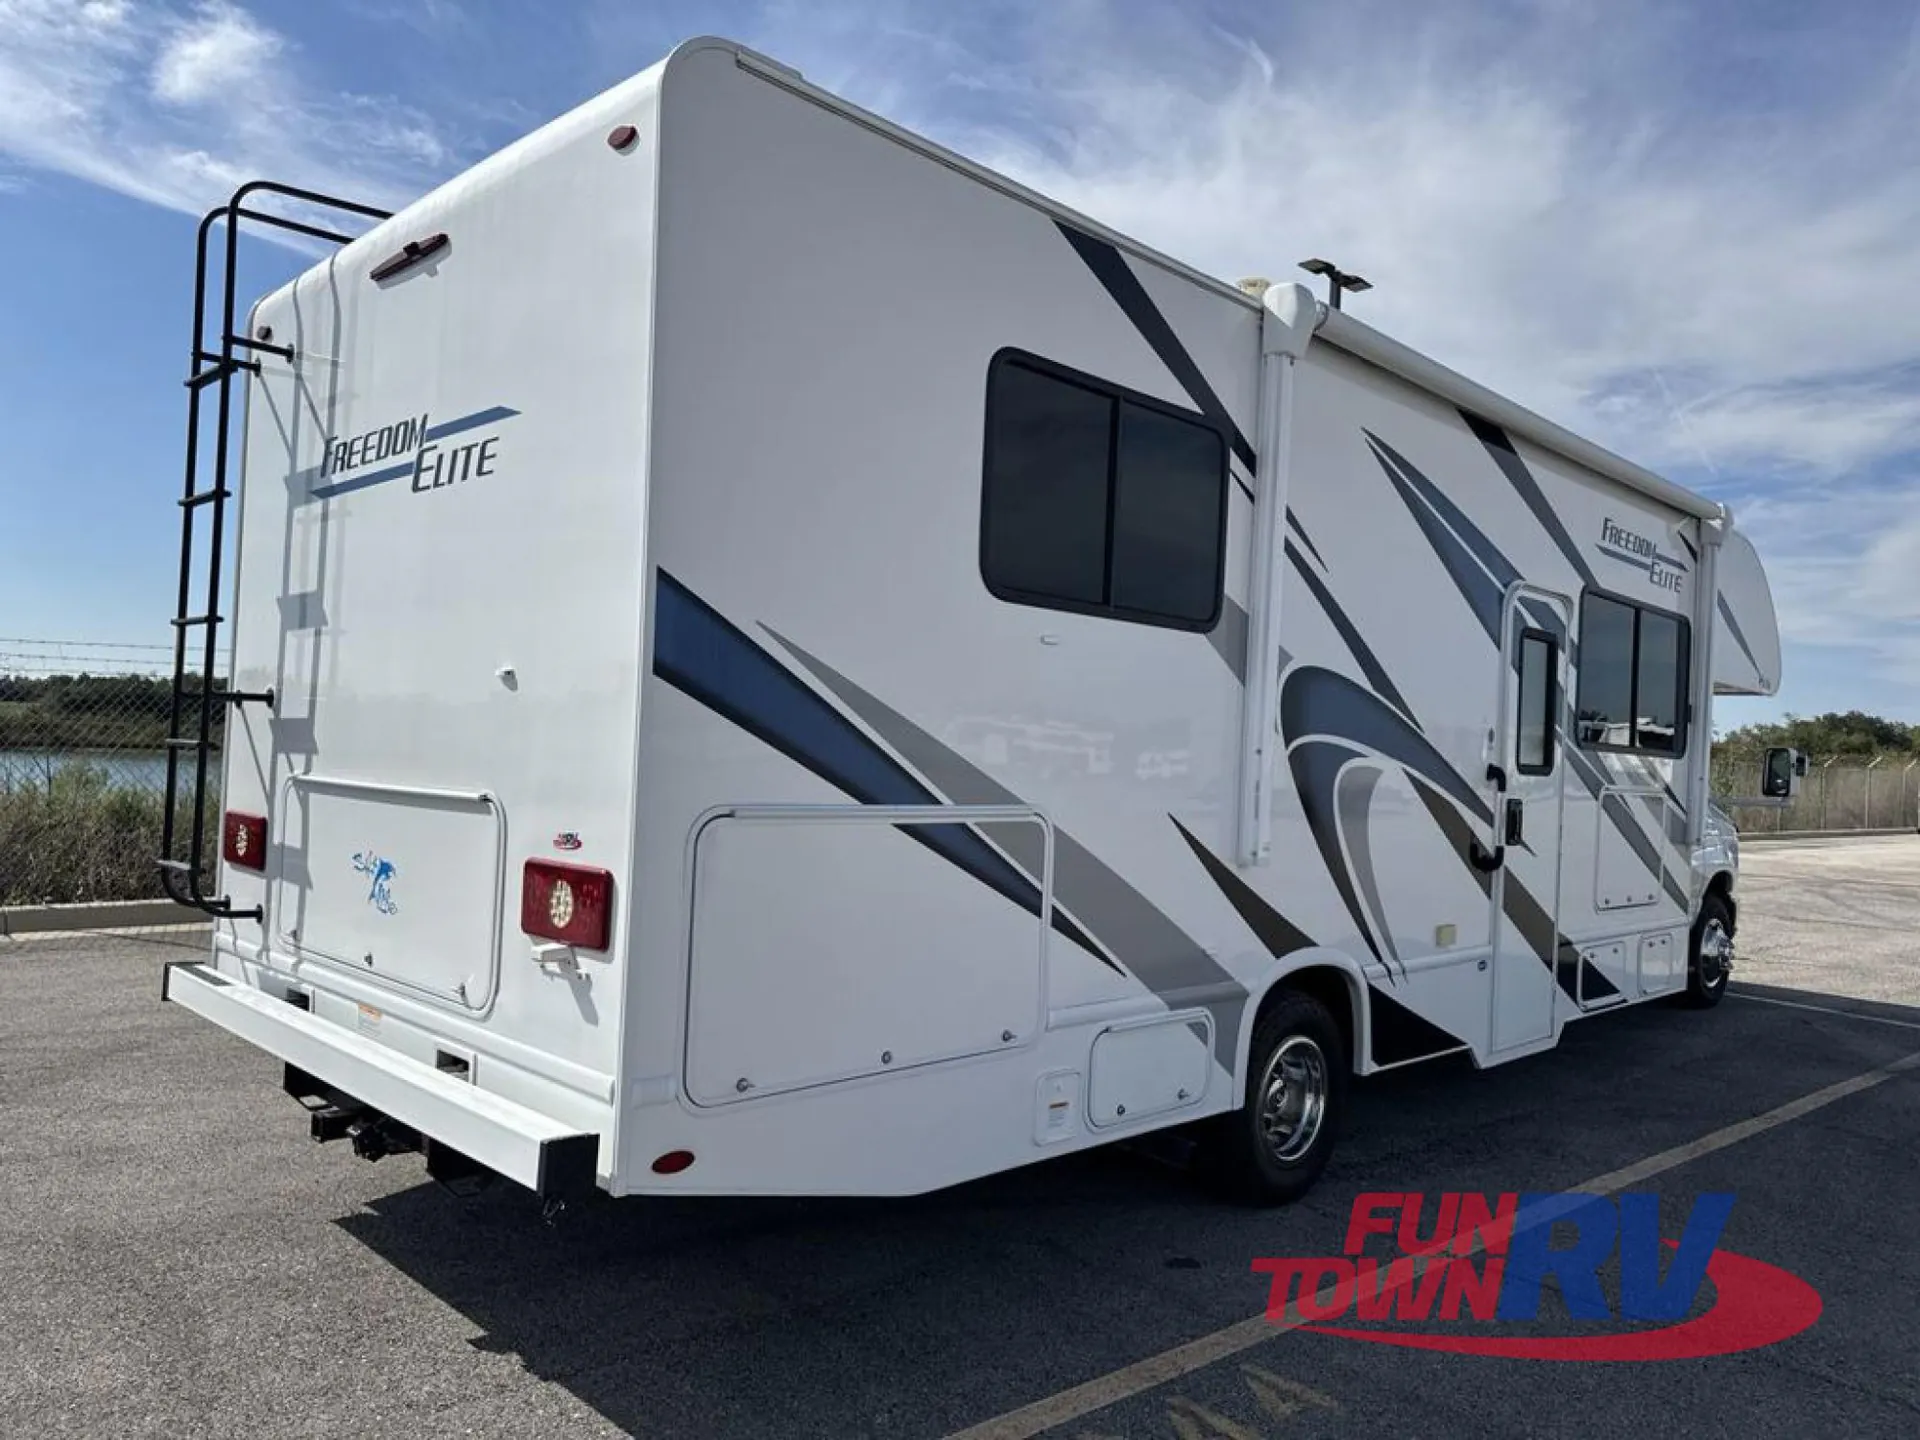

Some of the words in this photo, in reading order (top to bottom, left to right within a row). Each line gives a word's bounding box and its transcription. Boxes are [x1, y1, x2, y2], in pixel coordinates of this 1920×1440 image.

[320, 414, 429, 478] FREEDOM
[412, 437, 500, 494] ELITE
[1601, 517, 1657, 558] FREEDOM
[1650, 561, 1683, 593] ELITE
